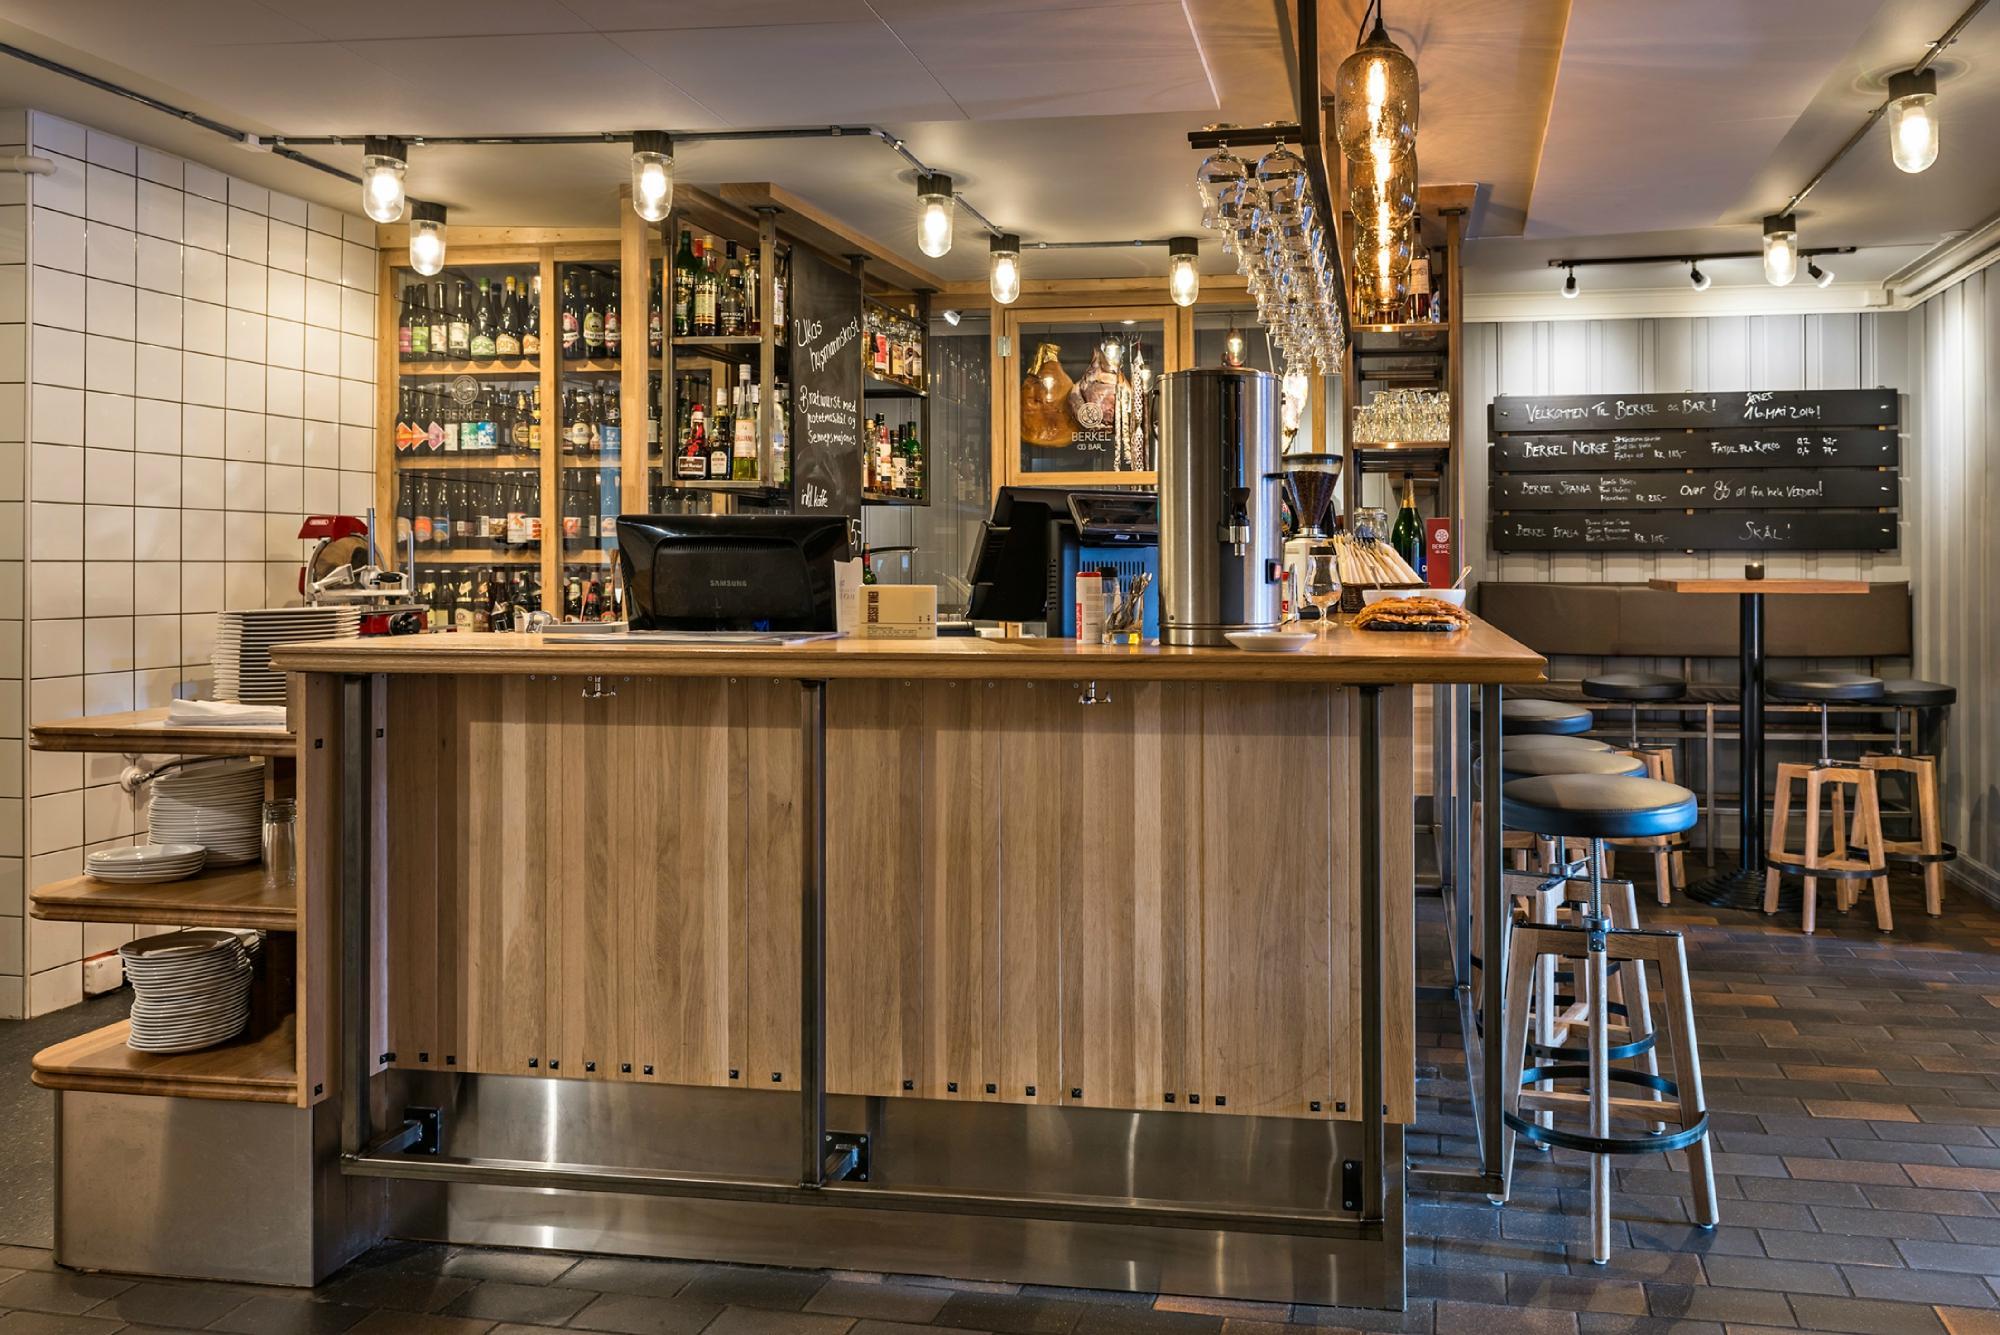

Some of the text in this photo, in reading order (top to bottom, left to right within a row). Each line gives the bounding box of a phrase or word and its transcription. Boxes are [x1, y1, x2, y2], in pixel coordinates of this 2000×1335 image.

[795, 318, 823, 346] Ukas
[798, 384, 857, 413] Bratwurst med
[1592, 401, 1610, 416] TIL
[1614, 399, 1659, 420] BERKEL
[847, 416, 856, 430] og
[1071, 431, 1111, 442] BERKEL
[1087, 443, 1107, 452] BAR
[1522, 440, 1567, 458] BERKEL
[1572, 440, 1609, 456] NORGE
[1520, 481, 1553, 496] BERKEL
[1558, 480, 1592, 496] SPANIA
[1679, 484, 1706, 496] Over
[1750, 485, 1764, 499] fra
[1767, 486, 1785, 497] hele
[1515, 523, 1547, 537] BERKEL
[1552, 526, 1580, 538] ITALIA
[709, 579, 748, 587] SAMSUNG
